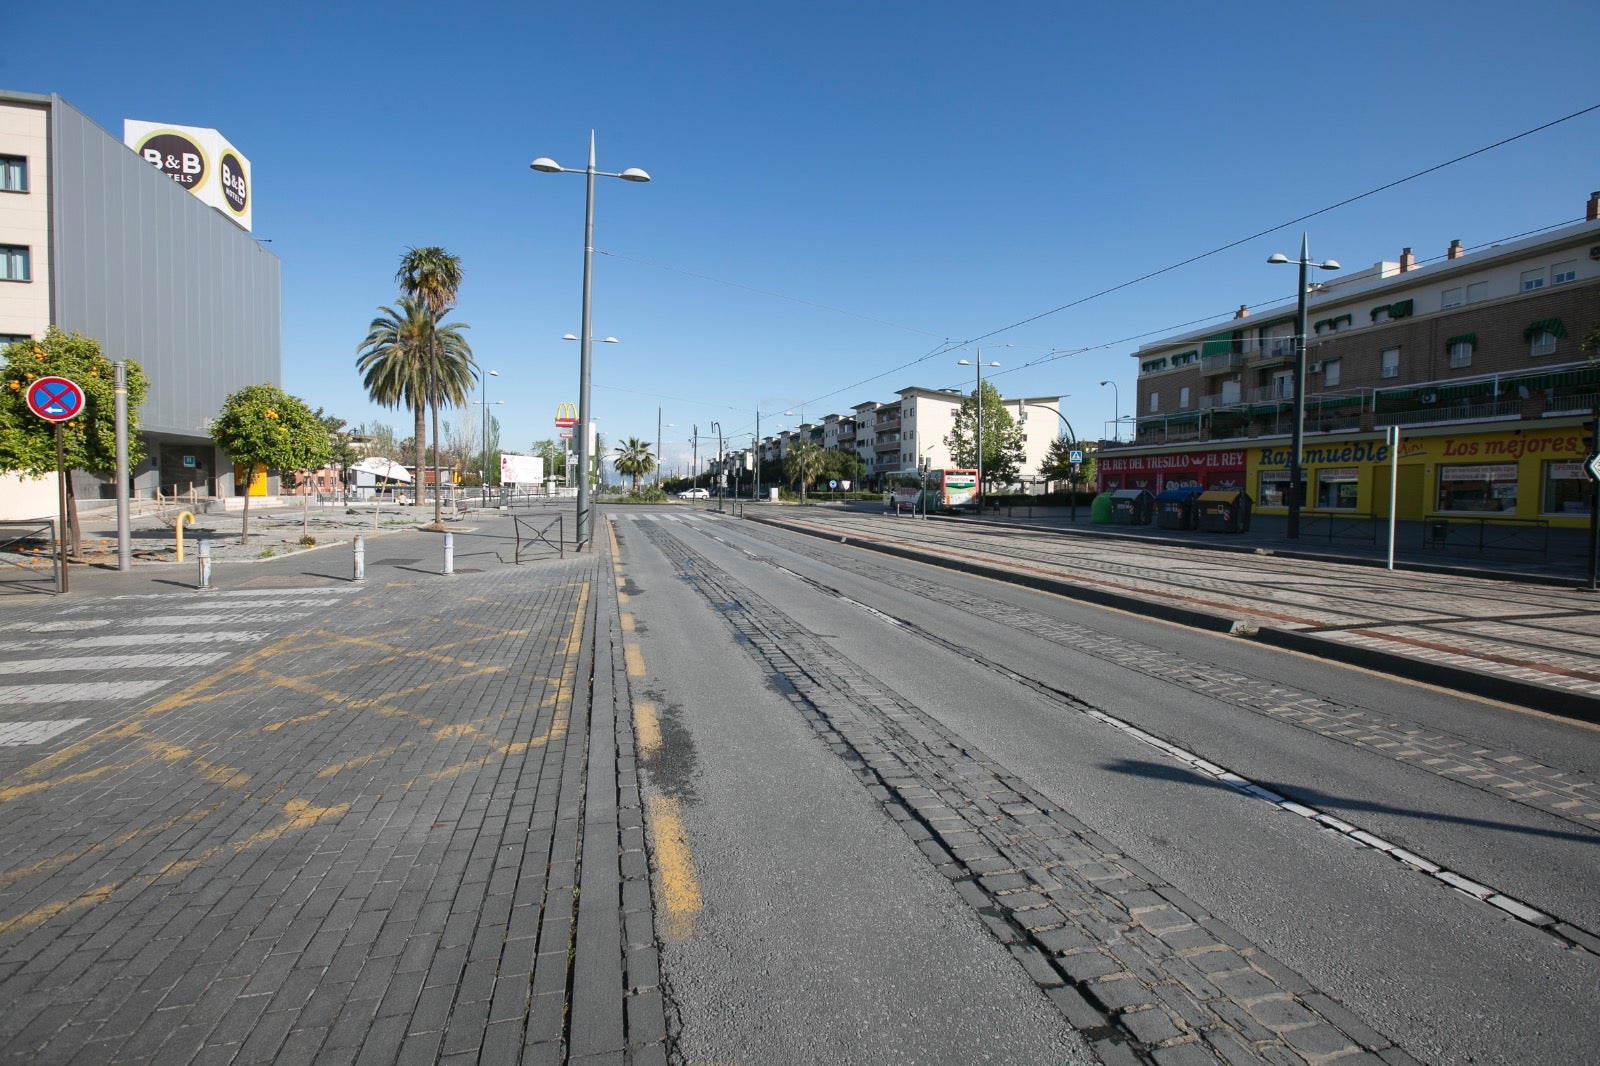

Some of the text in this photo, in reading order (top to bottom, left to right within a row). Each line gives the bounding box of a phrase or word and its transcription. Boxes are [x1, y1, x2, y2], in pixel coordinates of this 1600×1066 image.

[143, 148, 202, 174] B&B
[167, 173, 193, 183] TELS
[222, 163, 246, 199] B&B
[225, 187, 244, 205] HOTELS
[1443, 439, 1479, 457] Los
[1485, 435, 1577, 459] mejores
[1102, 454, 1190, 471] EL REY DEL TRESILLO
[1206, 451, 1244, 467] EL REY
